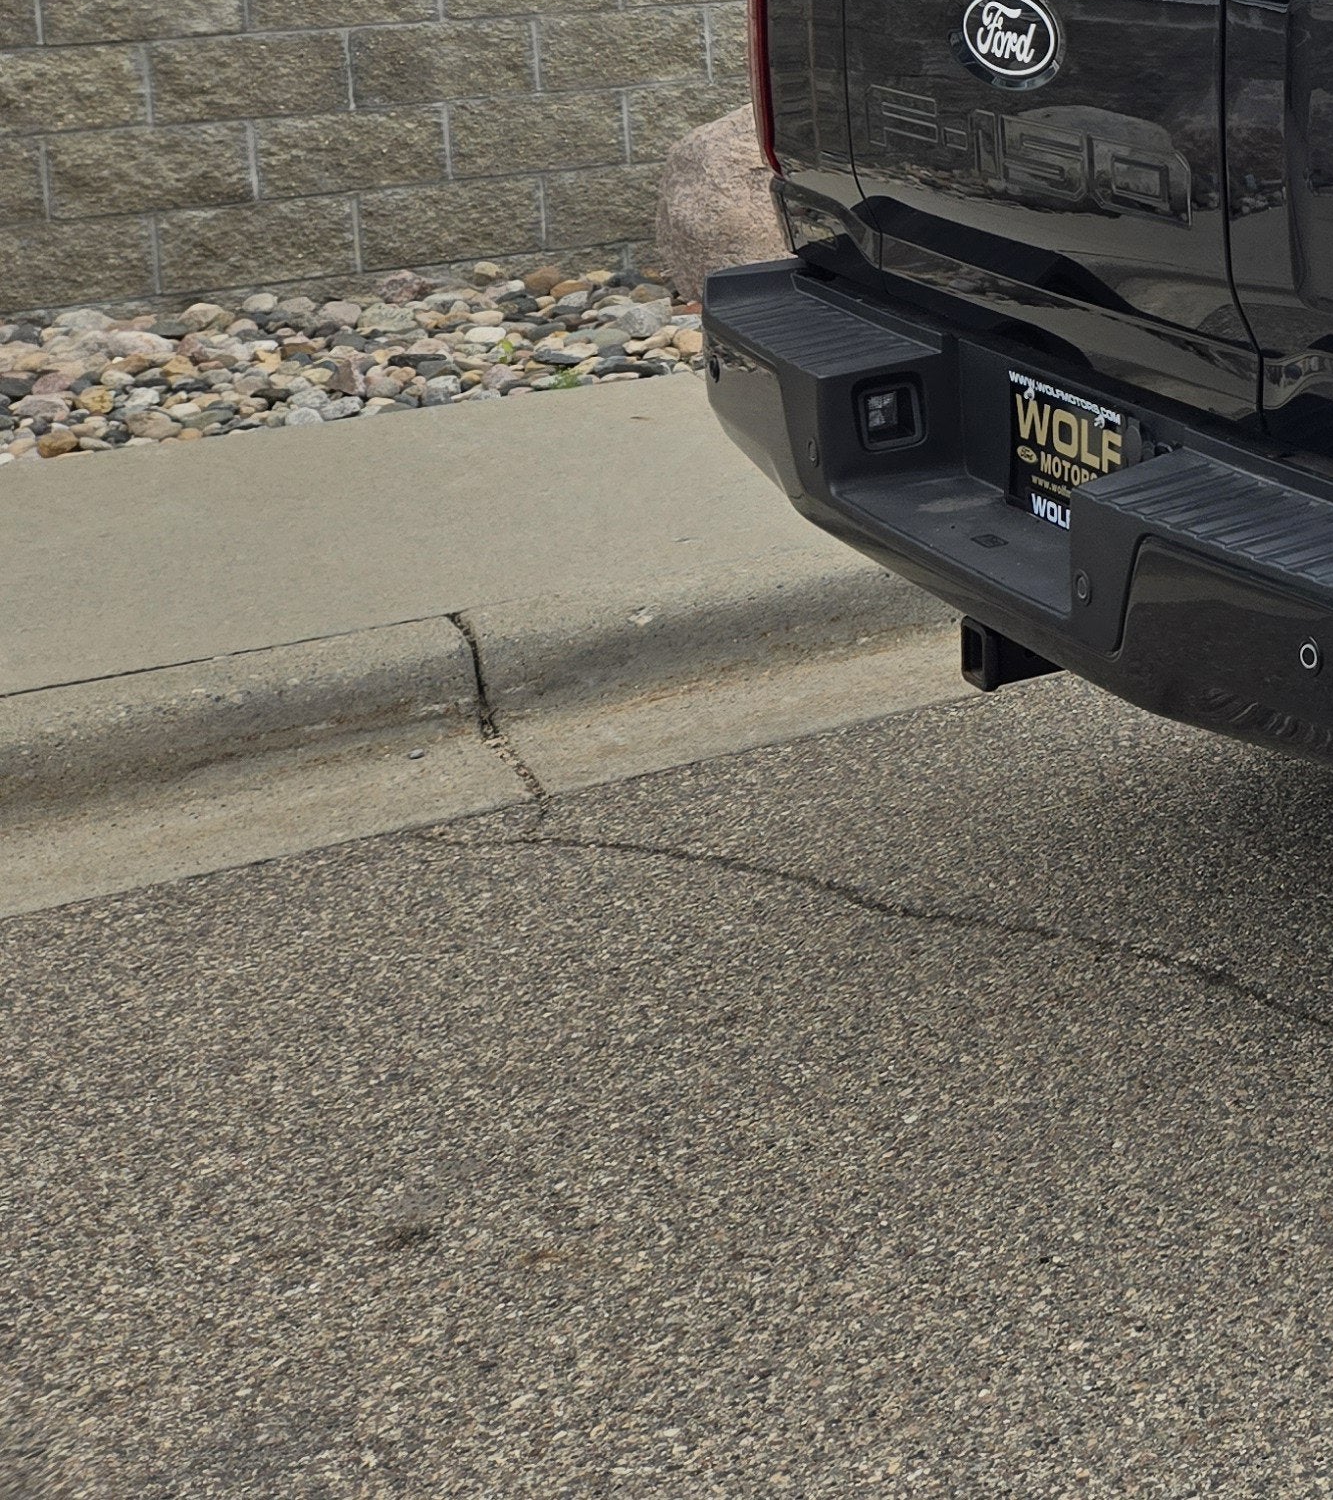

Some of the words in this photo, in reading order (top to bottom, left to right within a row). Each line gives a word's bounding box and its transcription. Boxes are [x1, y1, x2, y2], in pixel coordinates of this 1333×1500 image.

[976, 1, 1036, 63] Ford
[866, 83, 1192, 229] F-150
[1015, 393, 1122, 474] WOLF
